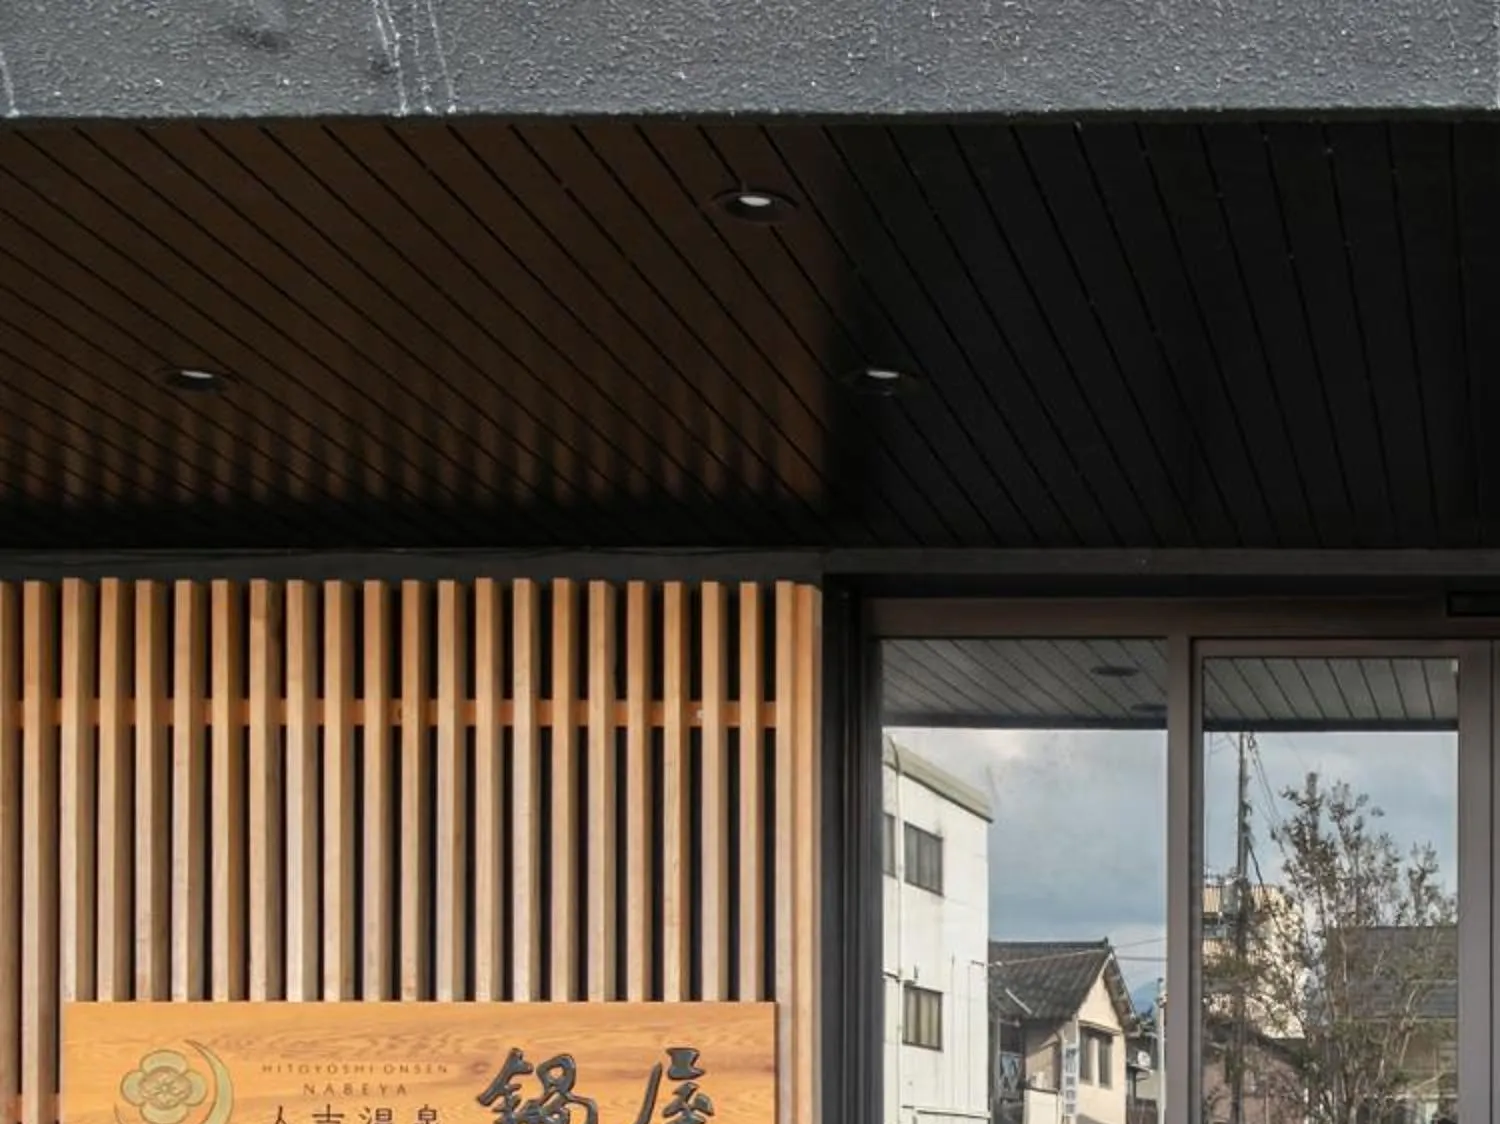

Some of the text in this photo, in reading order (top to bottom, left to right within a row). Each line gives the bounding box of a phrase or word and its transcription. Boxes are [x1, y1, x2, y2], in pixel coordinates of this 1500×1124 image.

[262, 1063, 448, 1074] HITOYOSHI ONSEN
[303, 1083, 408, 1096] NABEYA
